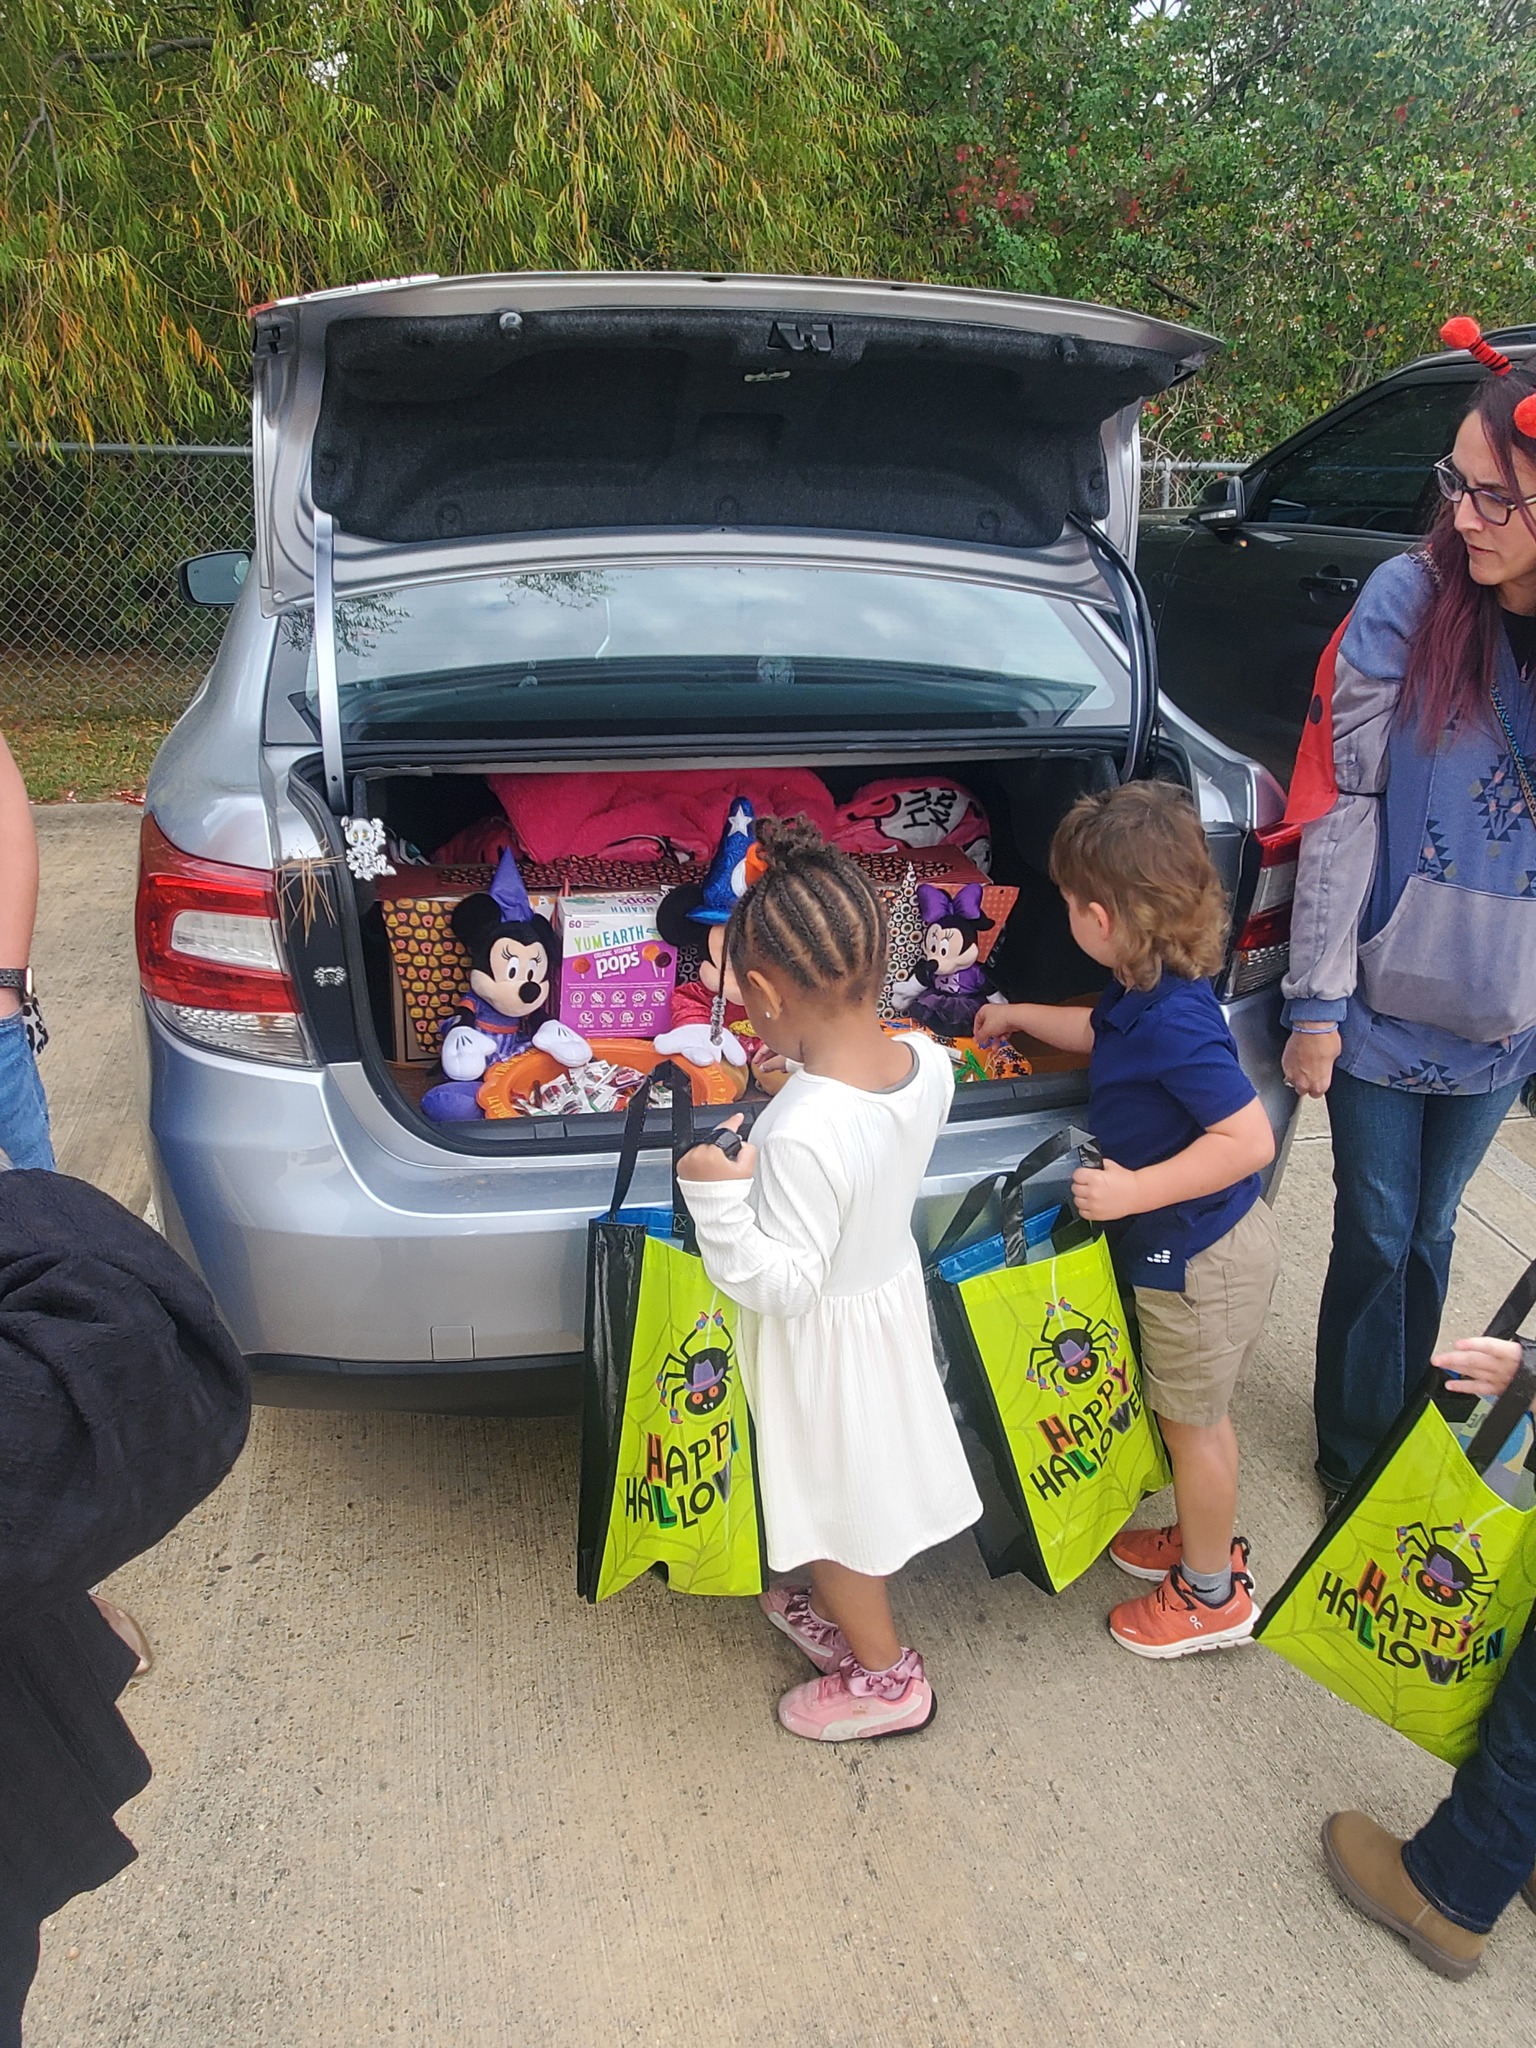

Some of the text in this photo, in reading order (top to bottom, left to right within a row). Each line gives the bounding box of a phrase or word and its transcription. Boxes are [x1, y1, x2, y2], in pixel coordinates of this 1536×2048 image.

[568, 920, 582, 929] 60
[574, 925, 645, 952] YUMEARTH
[596, 951, 640, 979] pops
[1030, 1372, 1141, 1501] HALLOWEE
[1038, 1357, 1130, 1453] HAPPY
[1317, 1571, 1505, 1685] HALLOWEEN
[1358, 1559, 1484, 1653] HAPPY
